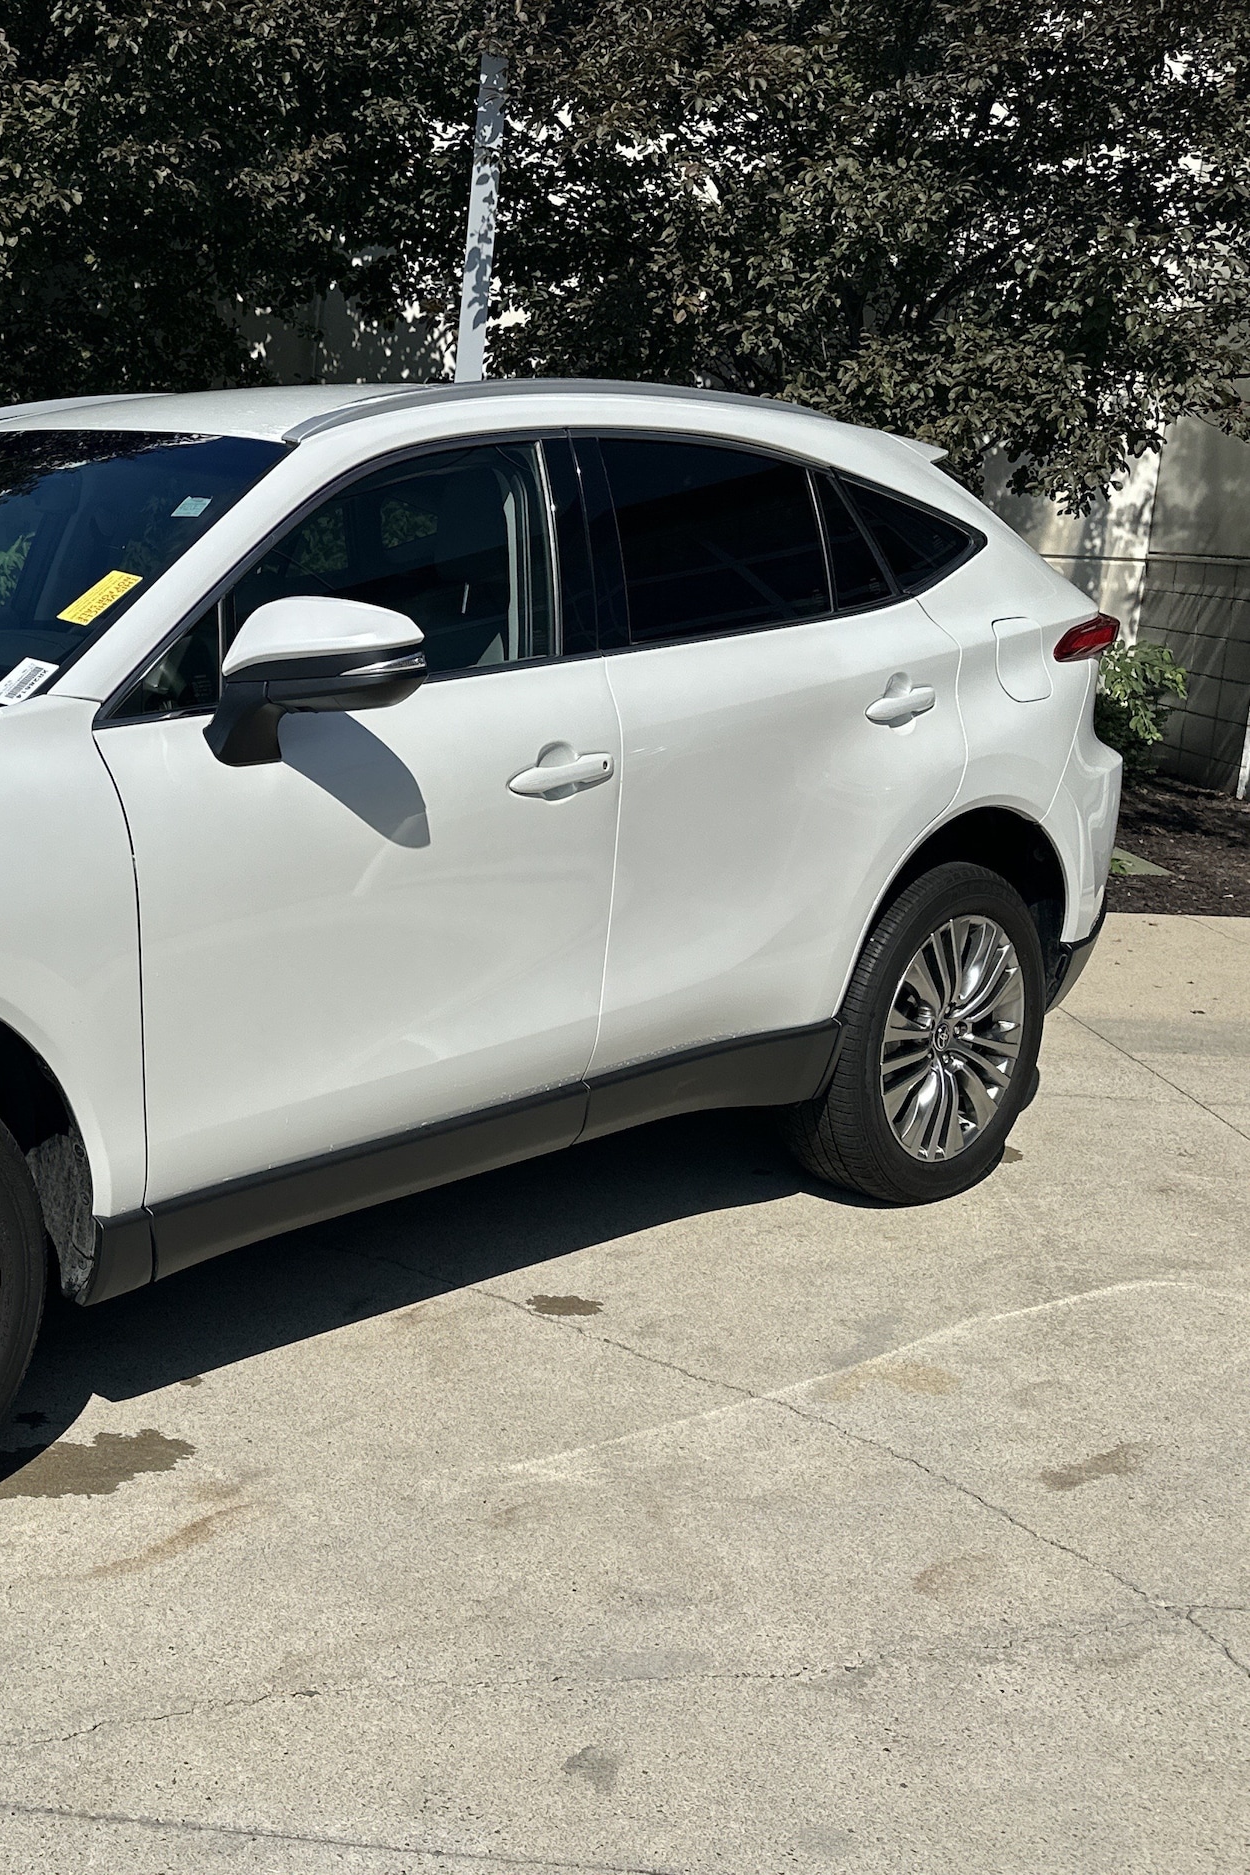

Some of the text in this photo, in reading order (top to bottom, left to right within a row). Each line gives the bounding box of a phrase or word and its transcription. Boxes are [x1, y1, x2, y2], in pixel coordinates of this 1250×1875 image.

[78, 576, 132, 621] NOT FOR SALE
[118, 577, 139, 592] THIS
[82, 594, 118, 623] VEHICLE
